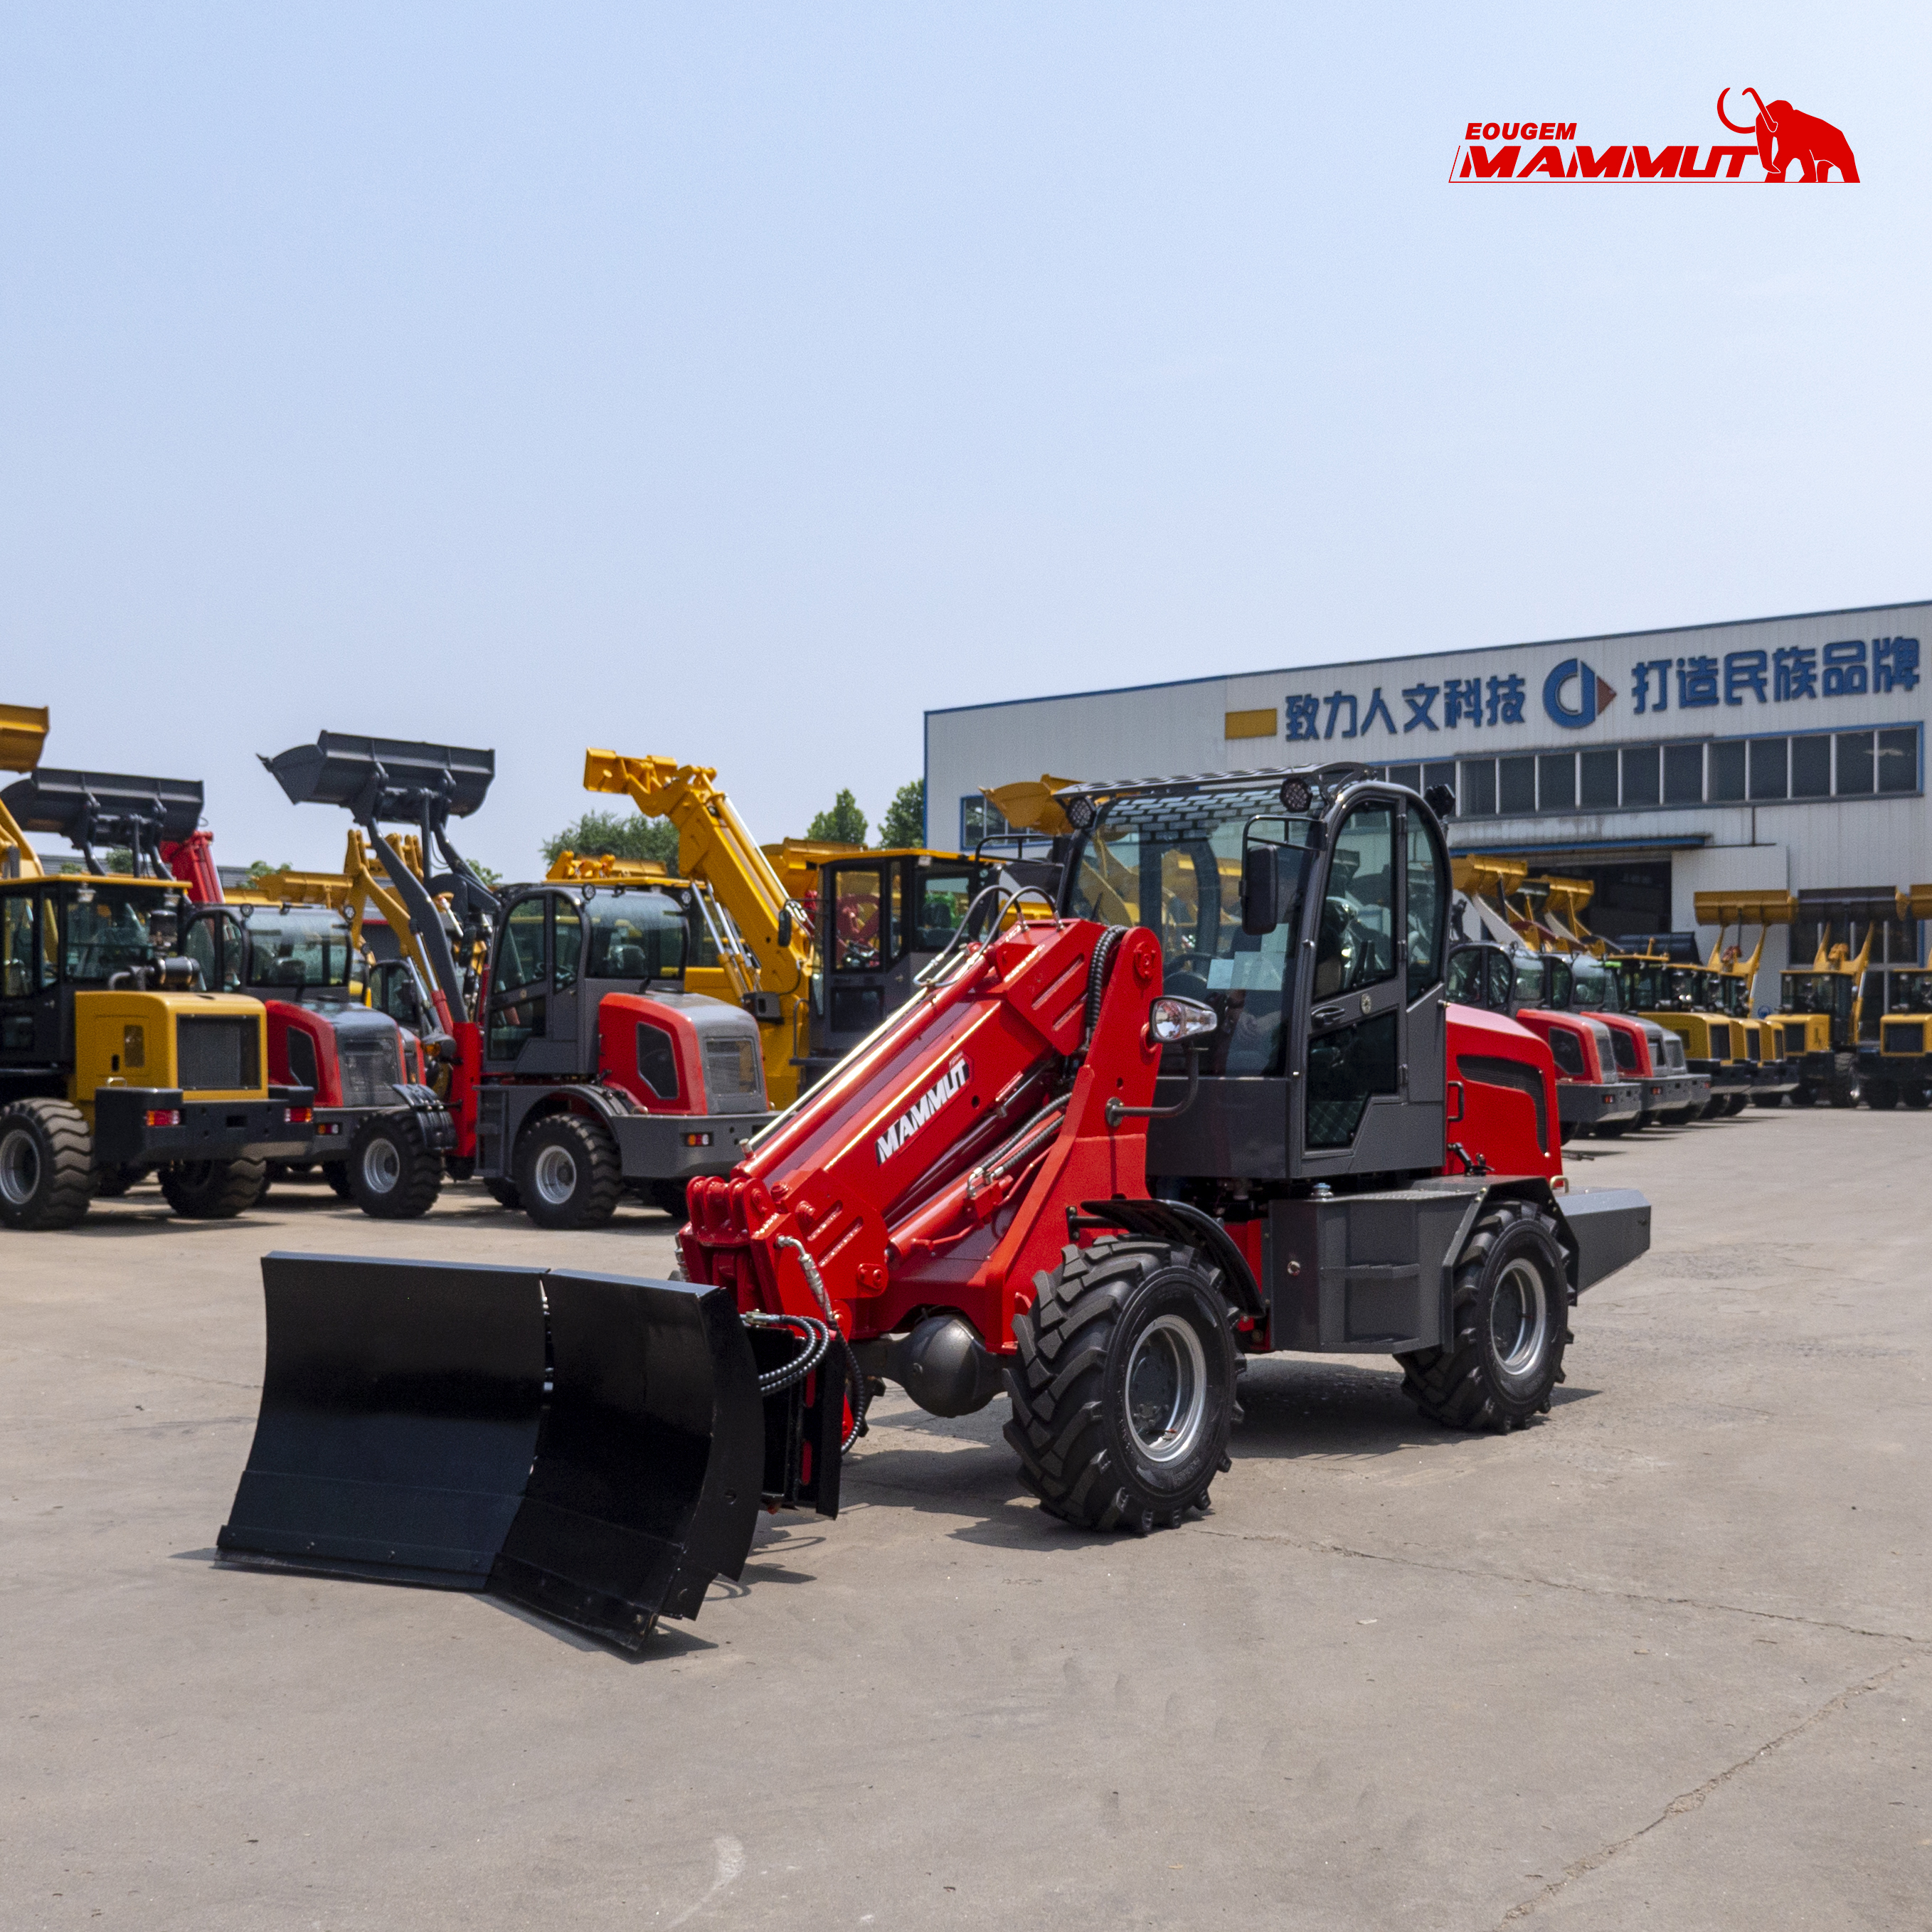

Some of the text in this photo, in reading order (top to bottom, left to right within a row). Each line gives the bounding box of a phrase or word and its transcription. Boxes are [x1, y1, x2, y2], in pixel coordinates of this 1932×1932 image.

[1285, 636, 1921, 741] 致力人文科技 打造民族品牌
[876, 1058, 967, 1164] MAMMUT
